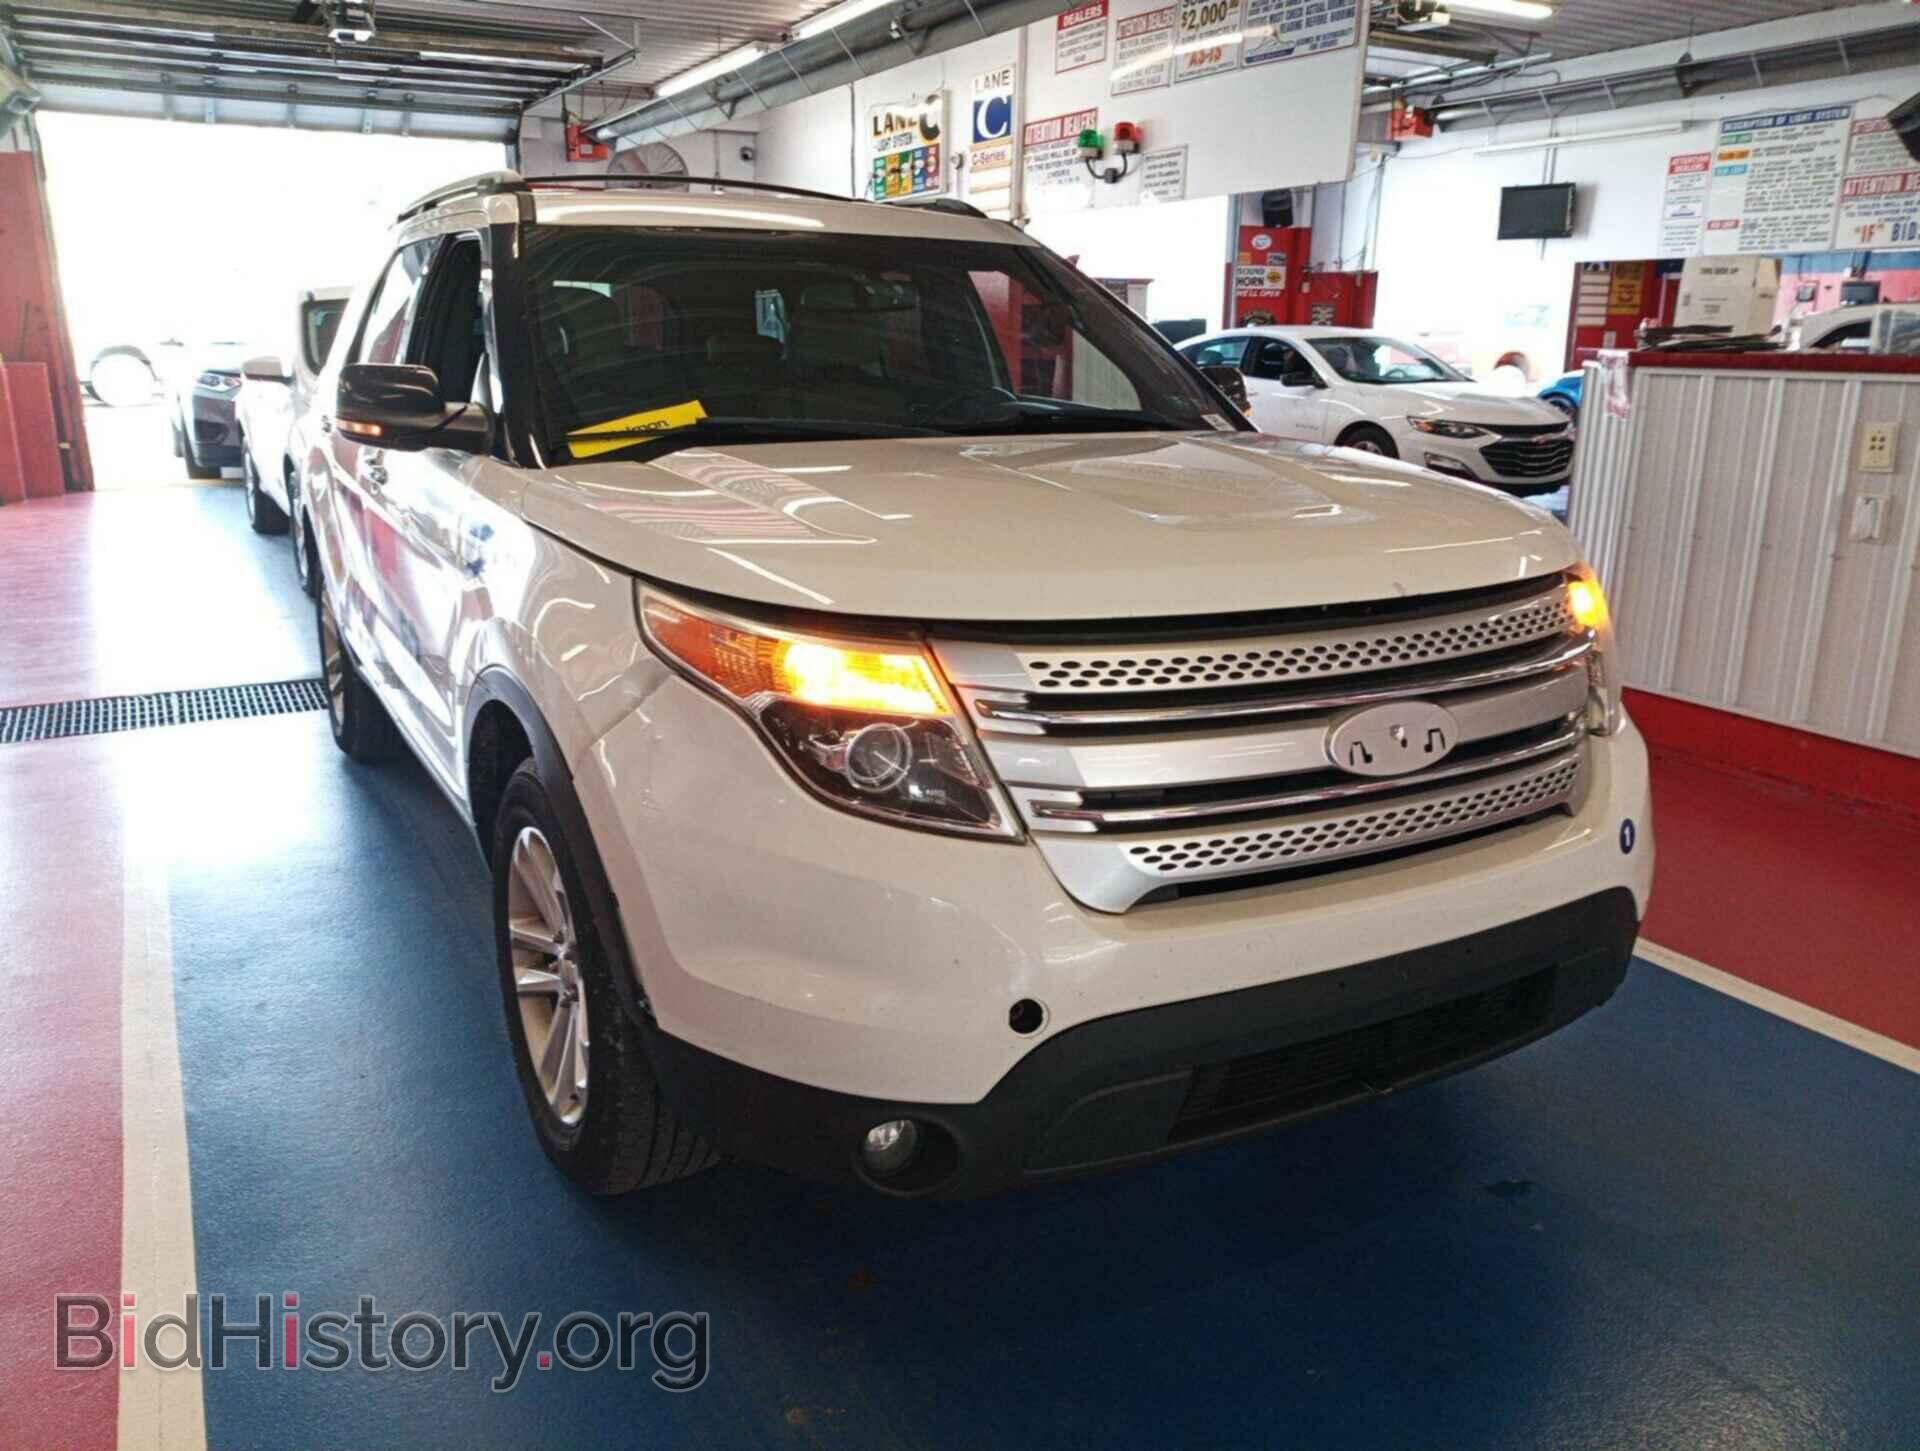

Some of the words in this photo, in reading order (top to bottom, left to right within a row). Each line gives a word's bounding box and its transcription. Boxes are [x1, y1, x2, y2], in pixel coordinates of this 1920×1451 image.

[1062, 5, 1103, 27] DEALERS
[974, 69, 1010, 89] LANE
[976, 96, 1008, 139] C
[971, 151, 1006, 166] C-Series
[1237, 277, 1264, 288] HORN
